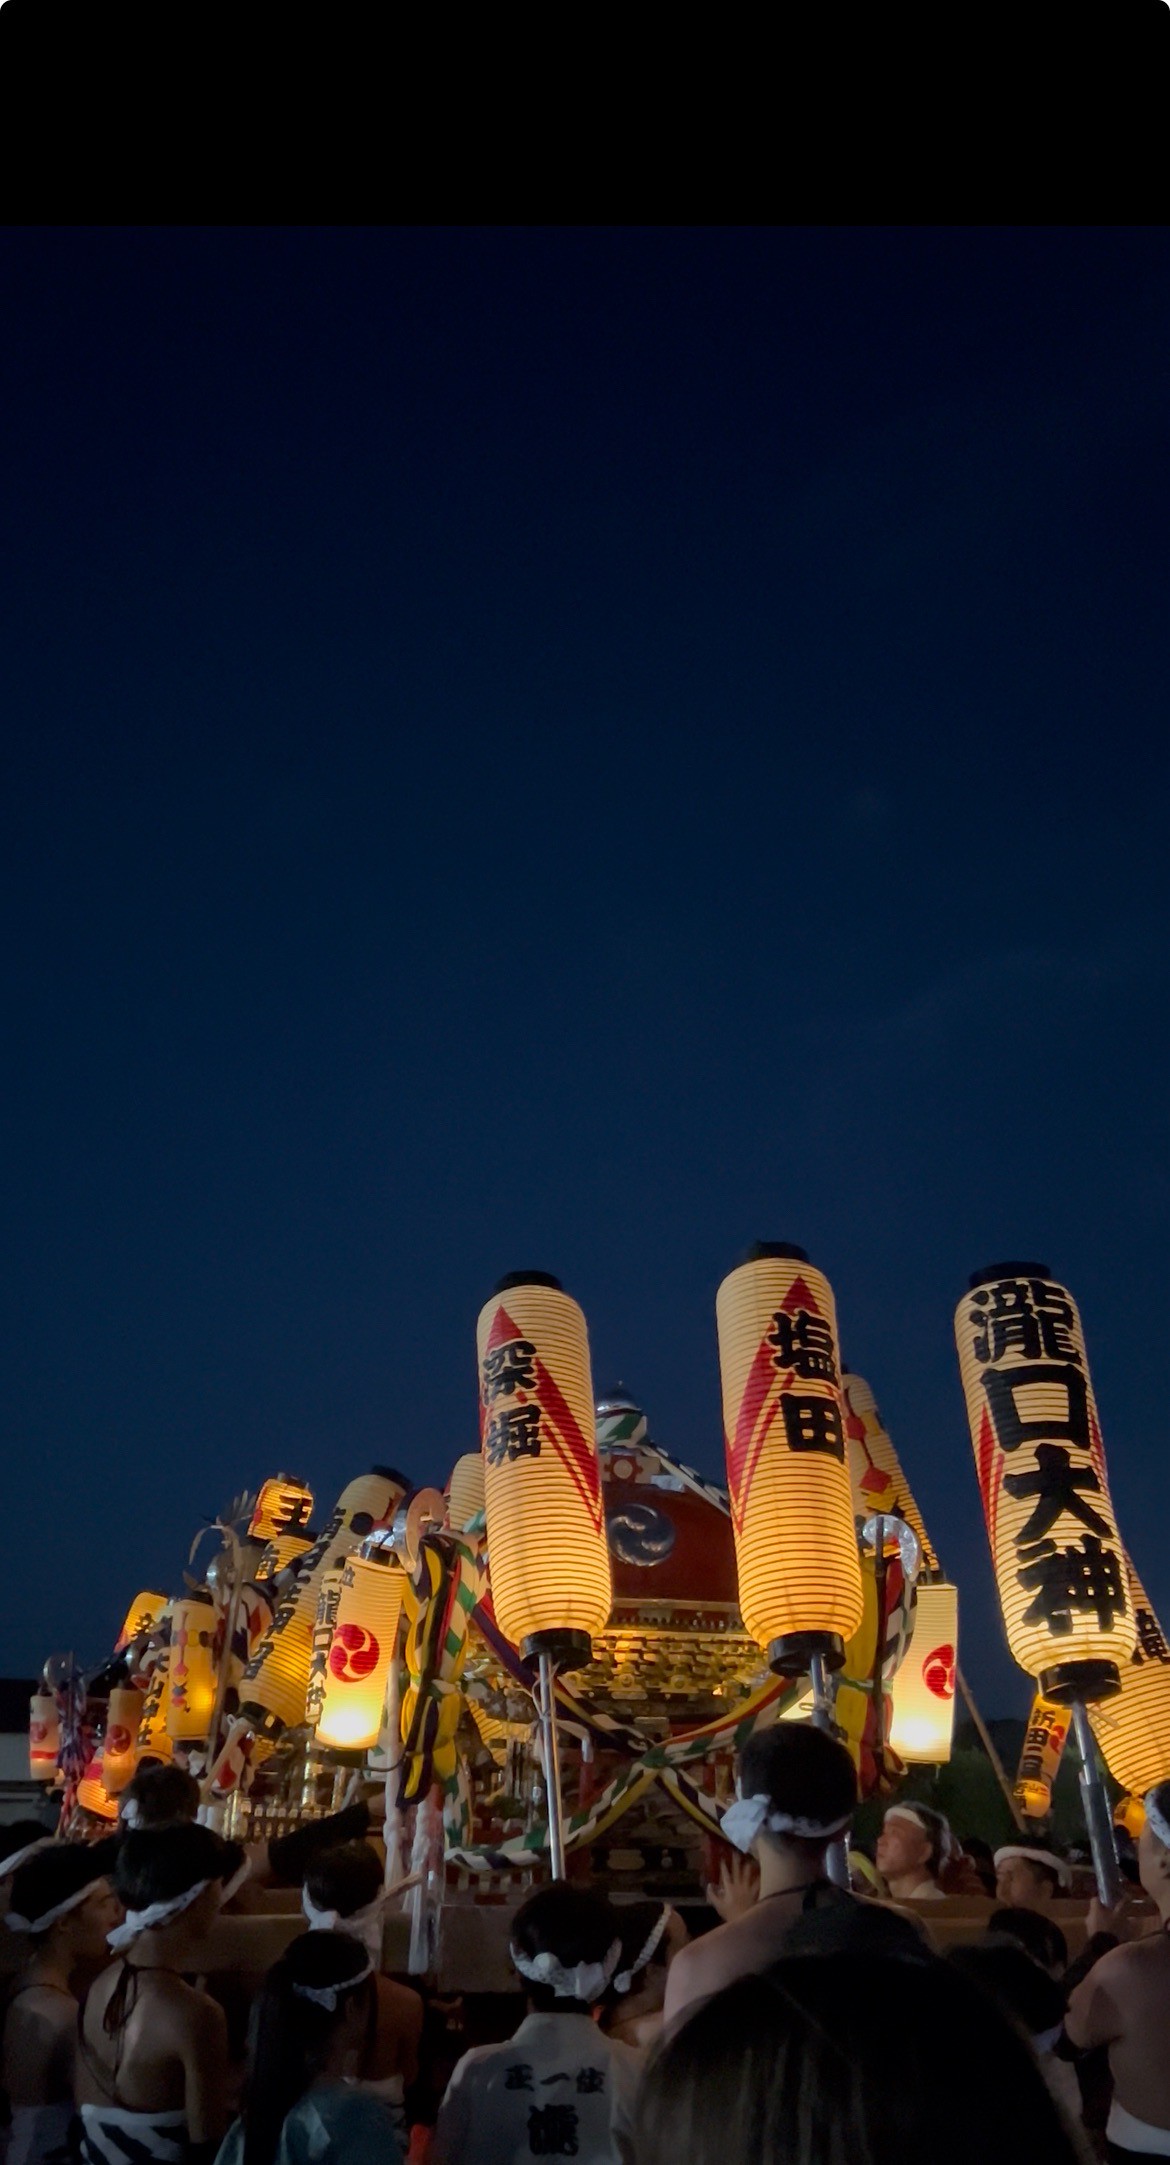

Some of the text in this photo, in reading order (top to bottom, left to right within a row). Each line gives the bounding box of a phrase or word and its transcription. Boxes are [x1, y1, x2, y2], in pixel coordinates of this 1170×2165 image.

[483, 1340, 542, 1467] 深堀
[767, 1310, 845, 1464] 塩田
[970, 1280, 1127, 1636] 瀧口大神
